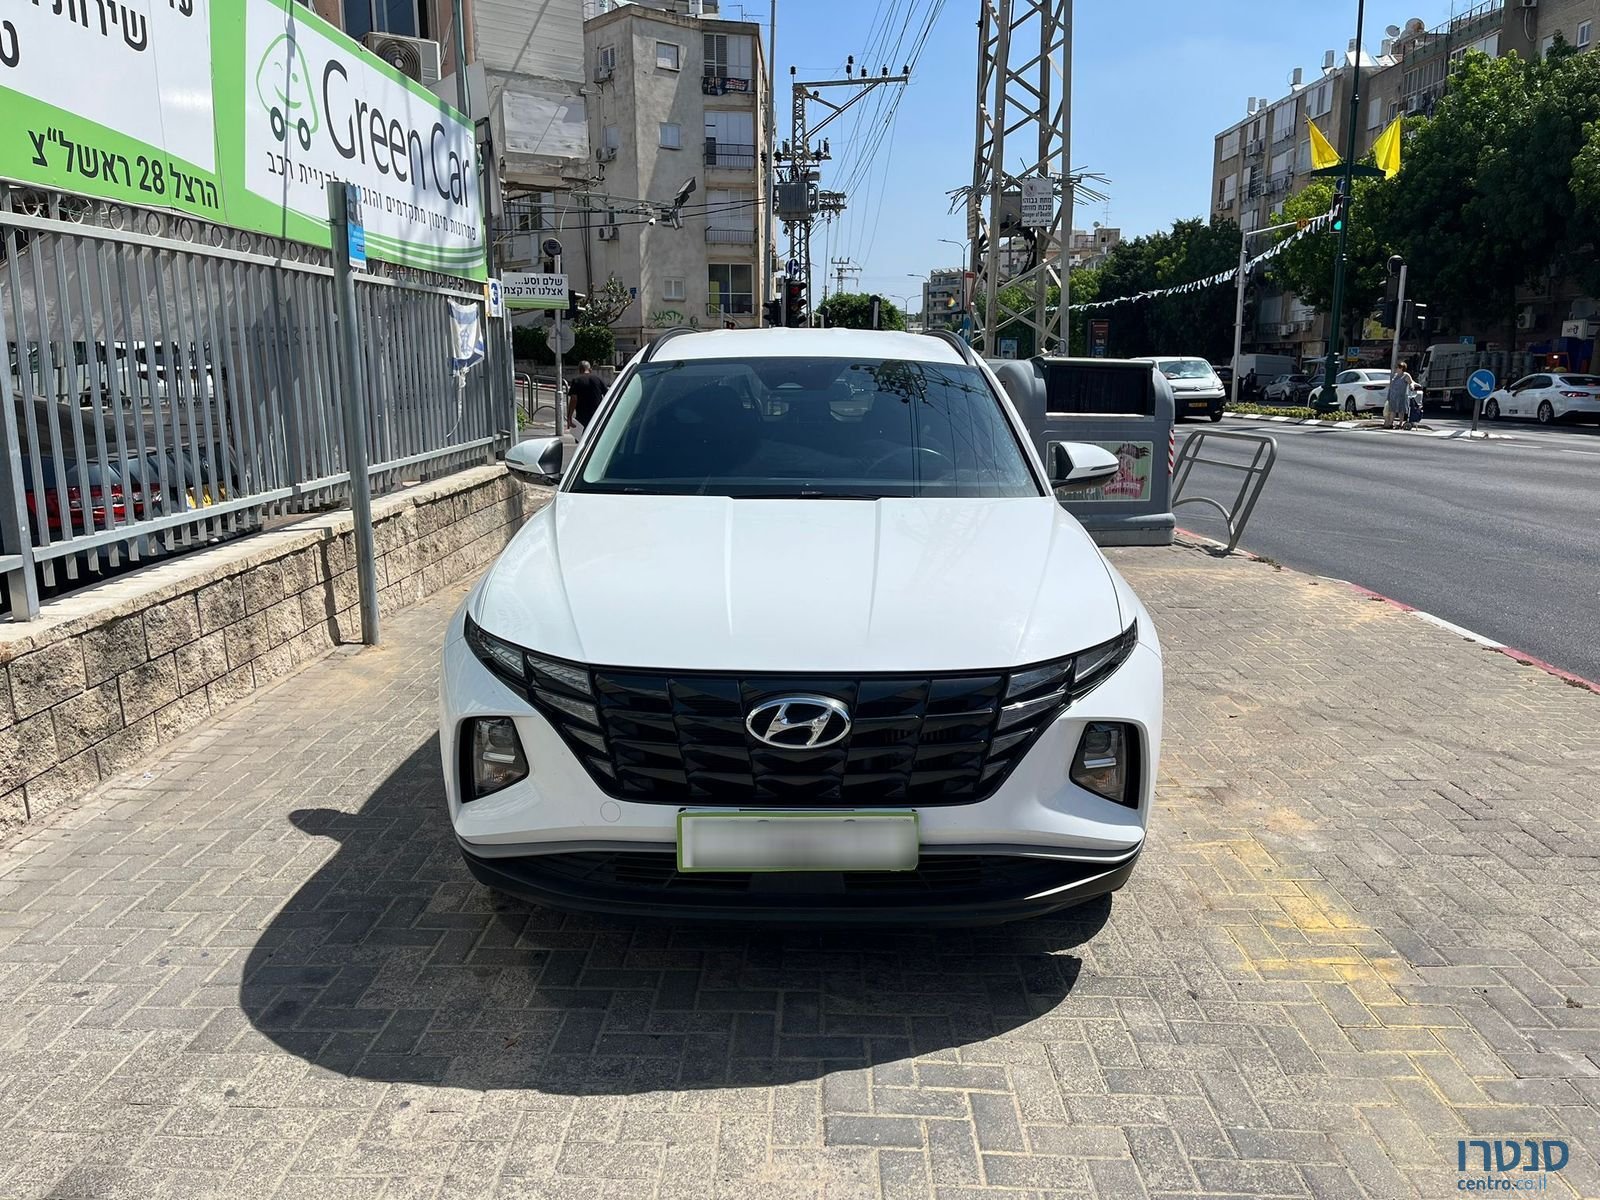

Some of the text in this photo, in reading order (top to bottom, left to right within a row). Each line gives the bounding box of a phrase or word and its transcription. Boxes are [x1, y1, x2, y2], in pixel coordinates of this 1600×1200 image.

[322, 59, 470, 208] Green Car
[136, 155, 165, 194] 28
[267, 151, 294, 179] רכב
[168, 162, 219, 209] הרצל
[386, 195, 426, 224] מתקדמים
[428, 211, 448, 231] מימון
[450, 219, 476, 240] פתרונות
[503, 286, 563, 297] אצלנו זה קצת
[542, 276, 563, 286] שלם
